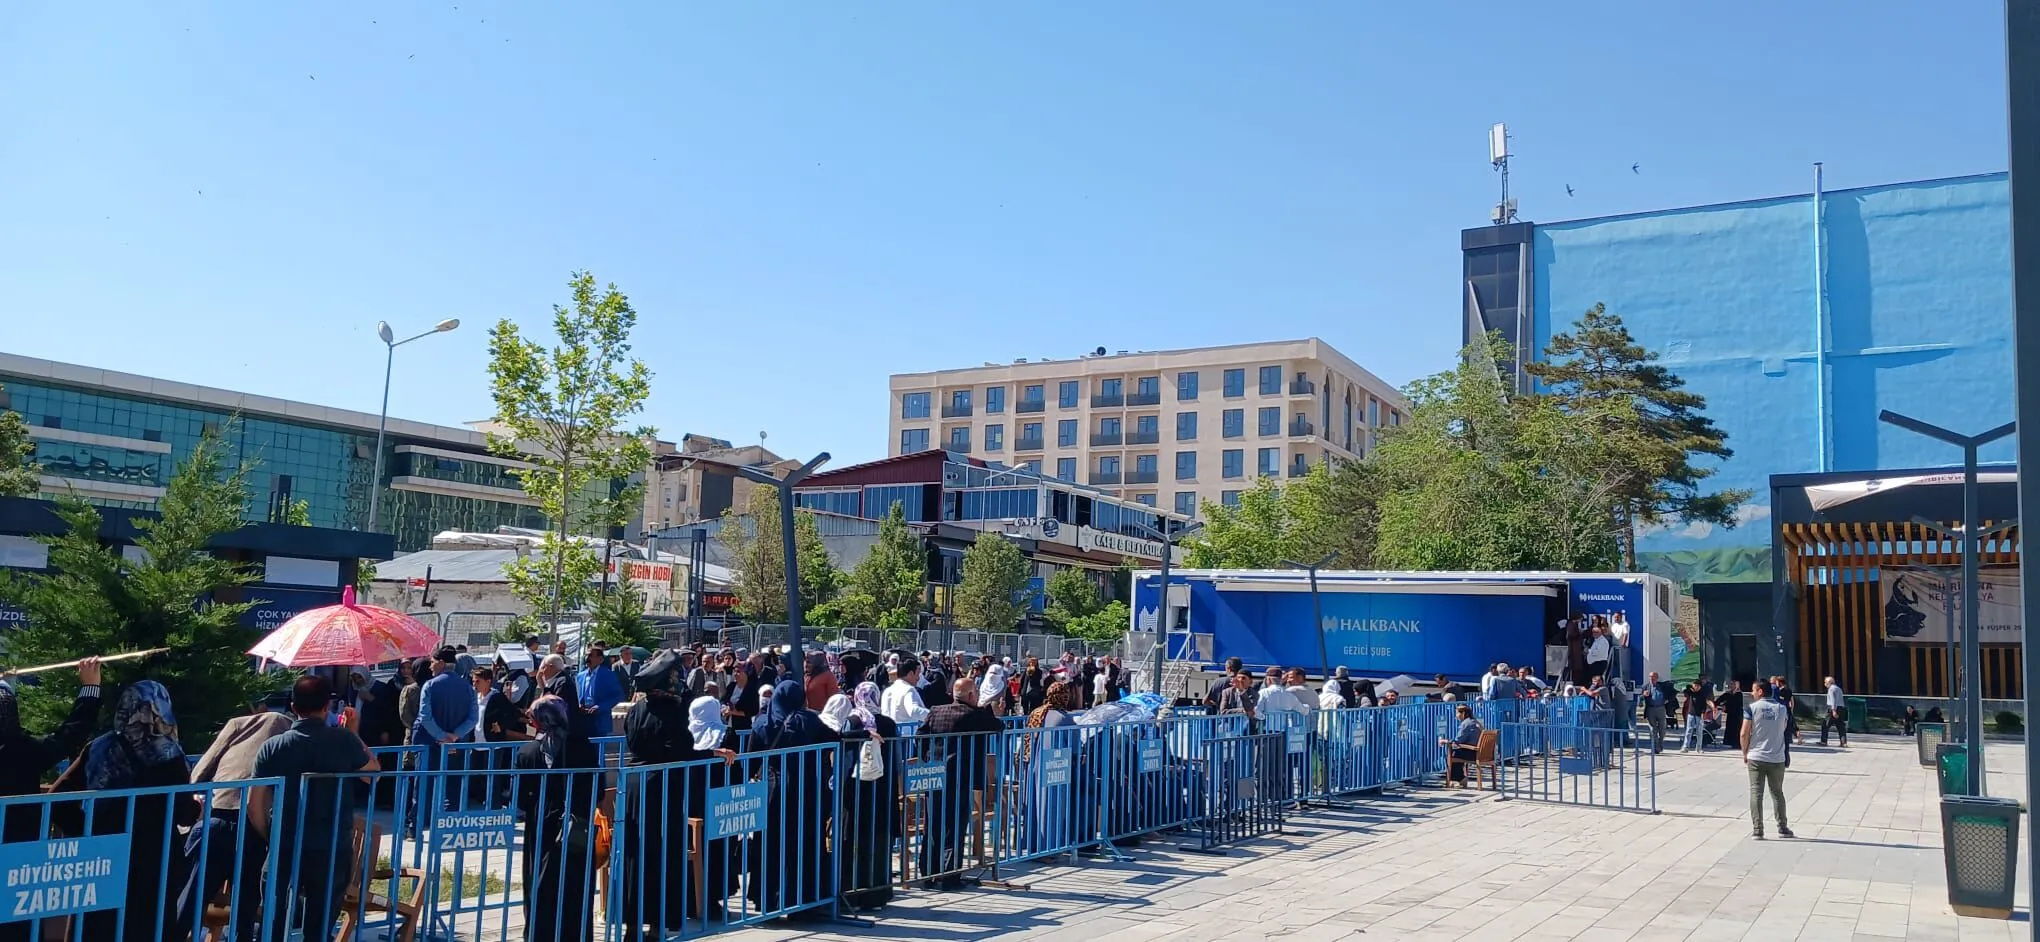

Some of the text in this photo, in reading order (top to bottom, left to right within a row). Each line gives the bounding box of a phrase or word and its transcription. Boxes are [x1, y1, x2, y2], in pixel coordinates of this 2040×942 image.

[257, 610, 278, 620] ÇOK
[1340, 618, 1420, 633] HALKBANK
[1343, 644, 1391, 657] GEZİCİ ŞUBE
[910, 777, 943, 791] ZABITA
[730, 786, 746, 799] VAN
[437, 814, 512, 829] BÜYÜKŞEHİR
[719, 813, 756, 836] ZABITA
[441, 831, 506, 850] ZABITA
[48, 841, 79, 859] VAN
[7, 857, 112, 887] BÜYÜKŞEHİR
[13, 883, 97, 916] ZABITA
